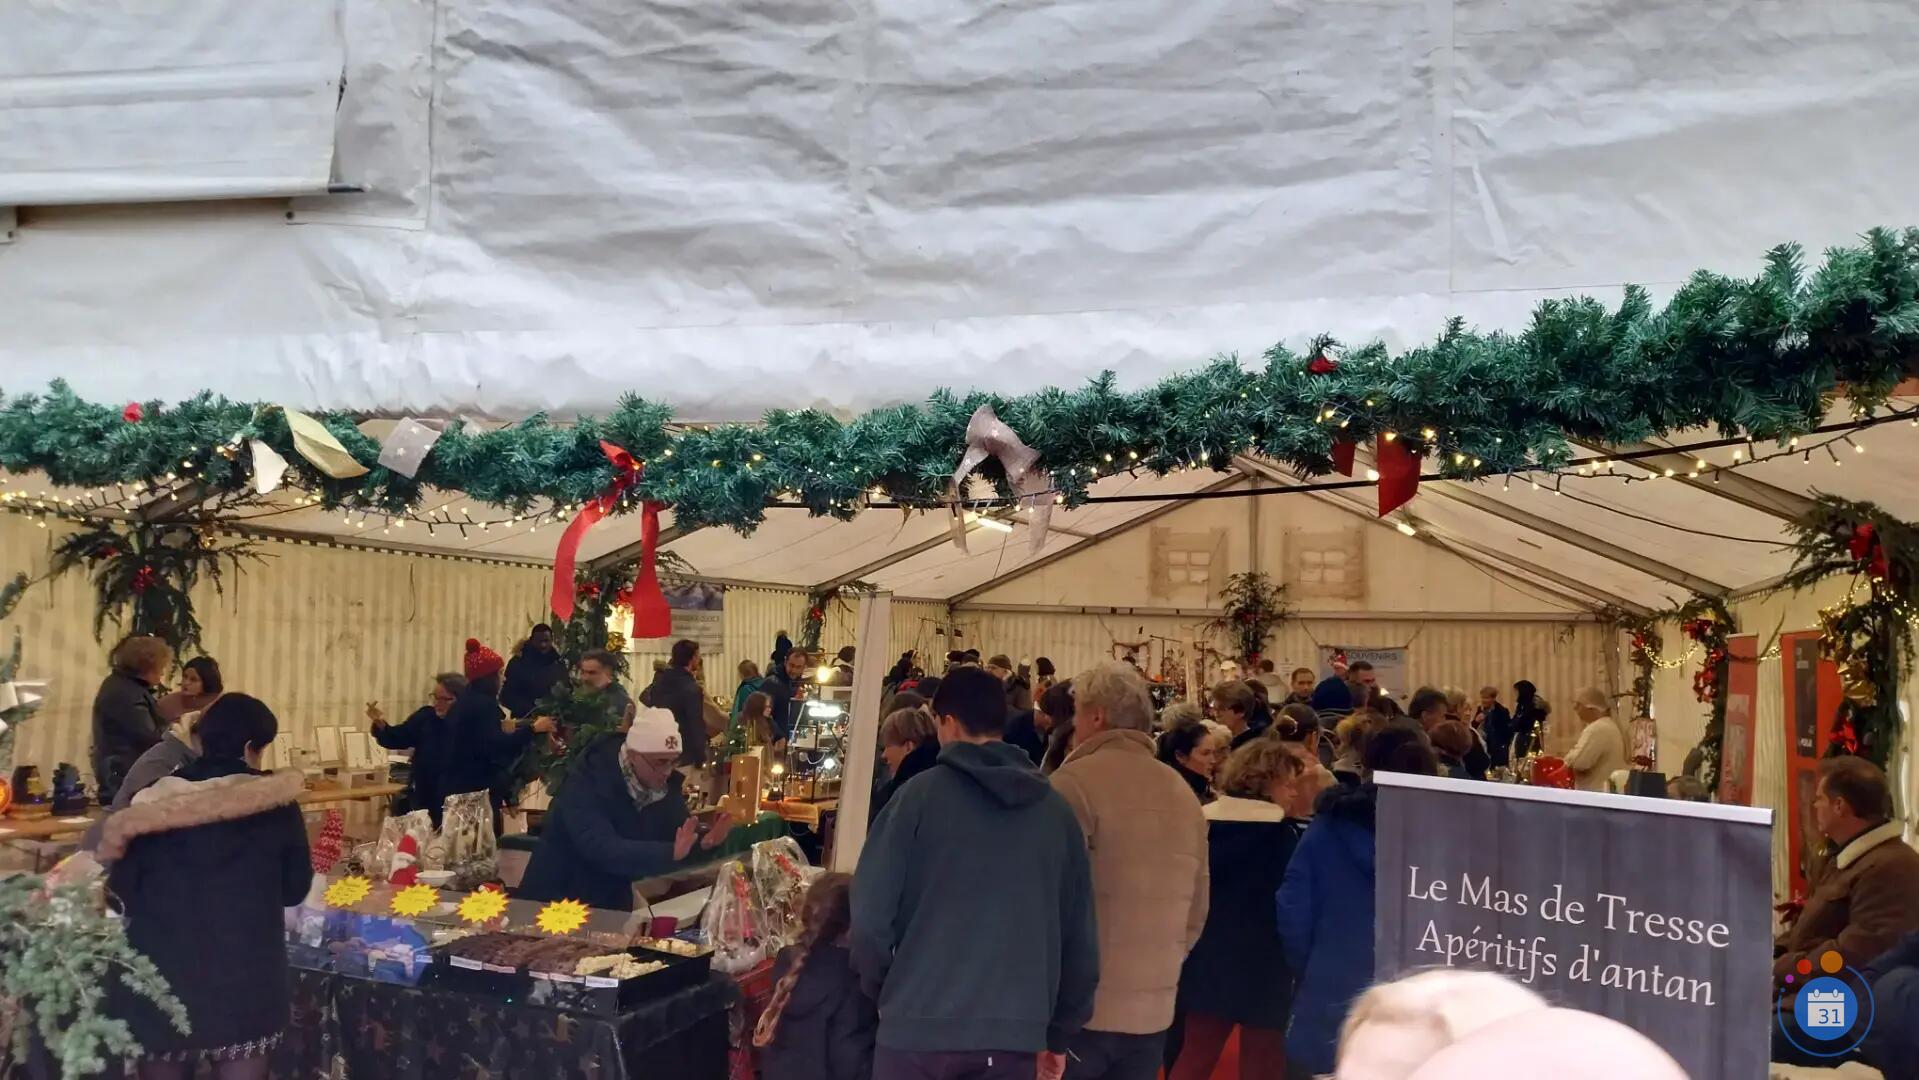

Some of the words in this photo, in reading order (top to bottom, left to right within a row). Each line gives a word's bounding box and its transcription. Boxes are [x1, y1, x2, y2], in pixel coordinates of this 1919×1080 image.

[1408, 865, 1448, 901] Le
[1457, 872, 1528, 916] Mas
[1540, 884, 1585, 925] de
[1597, 893, 1730, 948] Tresse
[1416, 919, 1557, 984] Apéritifs
[1569, 944, 1715, 1006] d'antan
